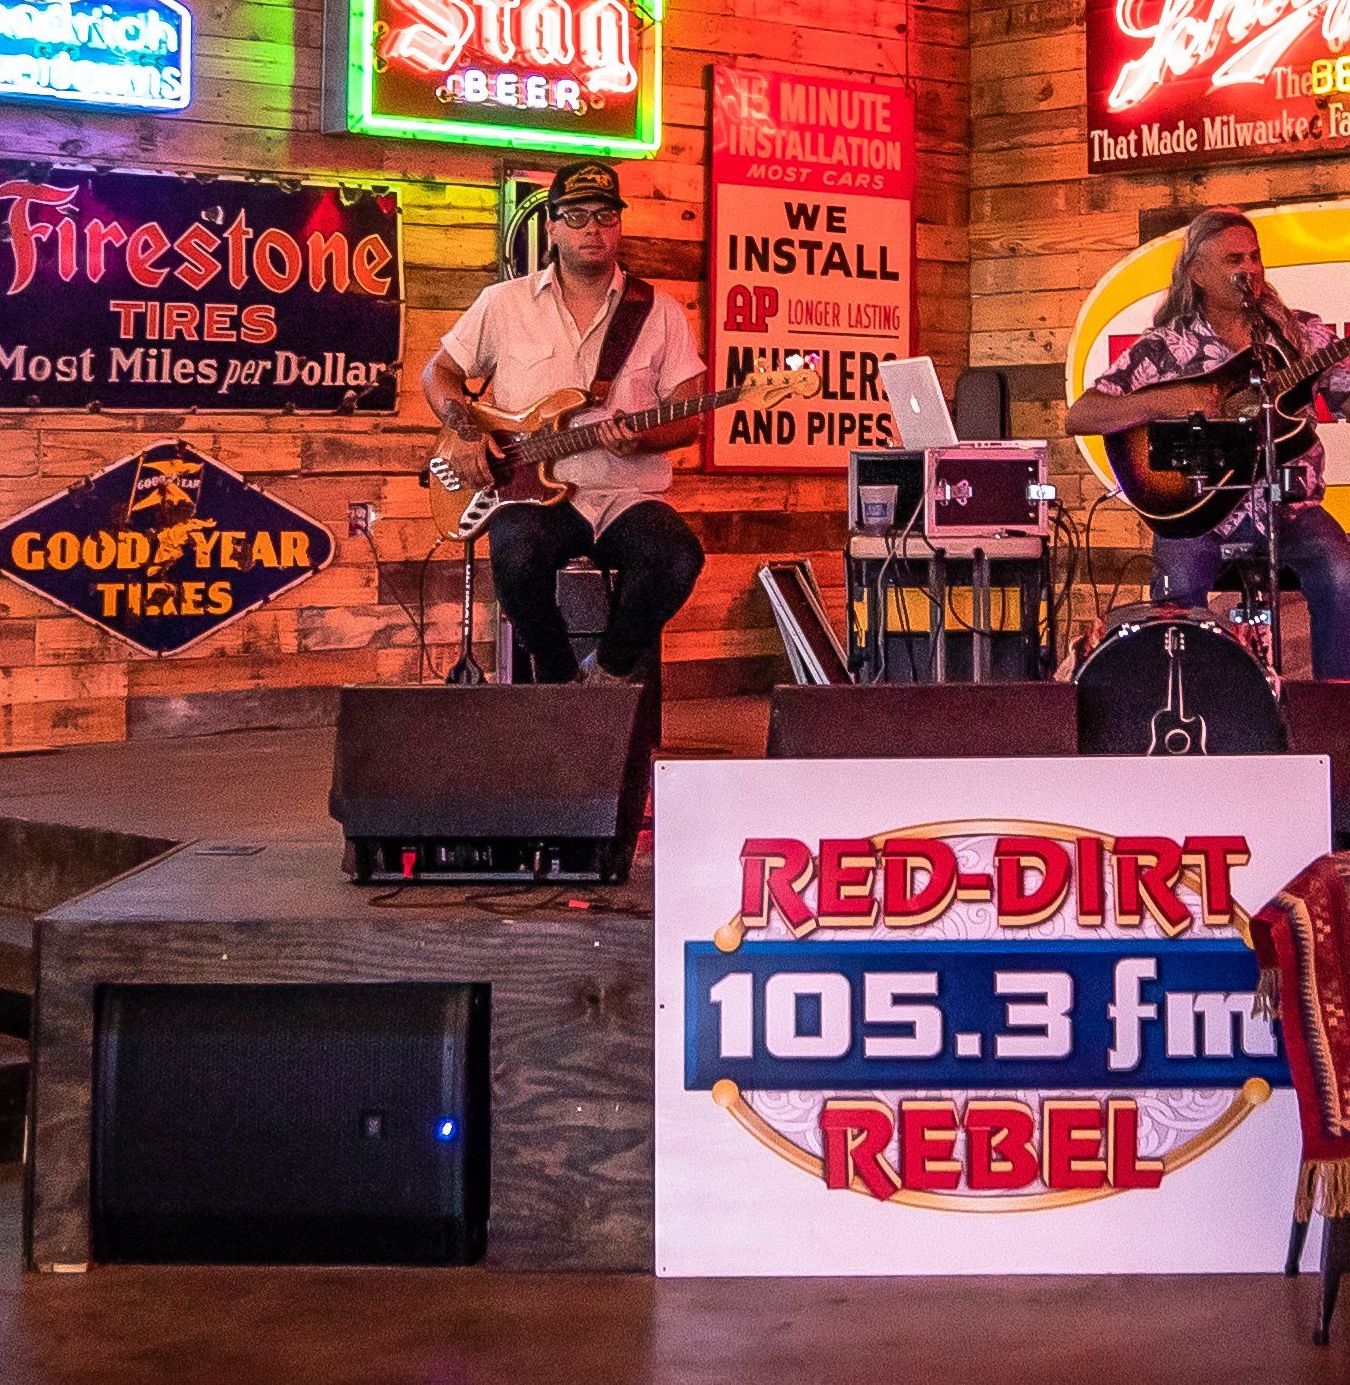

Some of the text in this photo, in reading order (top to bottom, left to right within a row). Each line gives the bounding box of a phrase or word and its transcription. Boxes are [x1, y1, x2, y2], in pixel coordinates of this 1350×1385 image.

[455, 69, 581, 111] BEER
[1272, 65, 1312, 99] The
[780, 82, 892, 133] MINUTE
[729, 123, 902, 172] INSTALLATION
[1090, 129, 1138, 163] That
[1141, 121, 1198, 157] Made
[746, 162, 885, 190] MOST CARS
[784, 201, 848, 234] WE
[728, 234, 900, 282] INSTALL
[110, 299, 277, 344] TIRES
[723, 283, 779, 333] AP
[788, 299, 900, 331] LONGER LASTING
[108, 348, 219, 384] Miles
[218, 358, 272, 395] per
[272, 350, 387, 388] Dollar
[728, 409, 893, 449] AND PIPES
[96, 580, 234, 618] TIRES
[739, 835, 1252, 938] RED-DIRT
[709, 956, 1279, 1073] 105.3 fm
[819, 1098, 1166, 1201] REBEL
